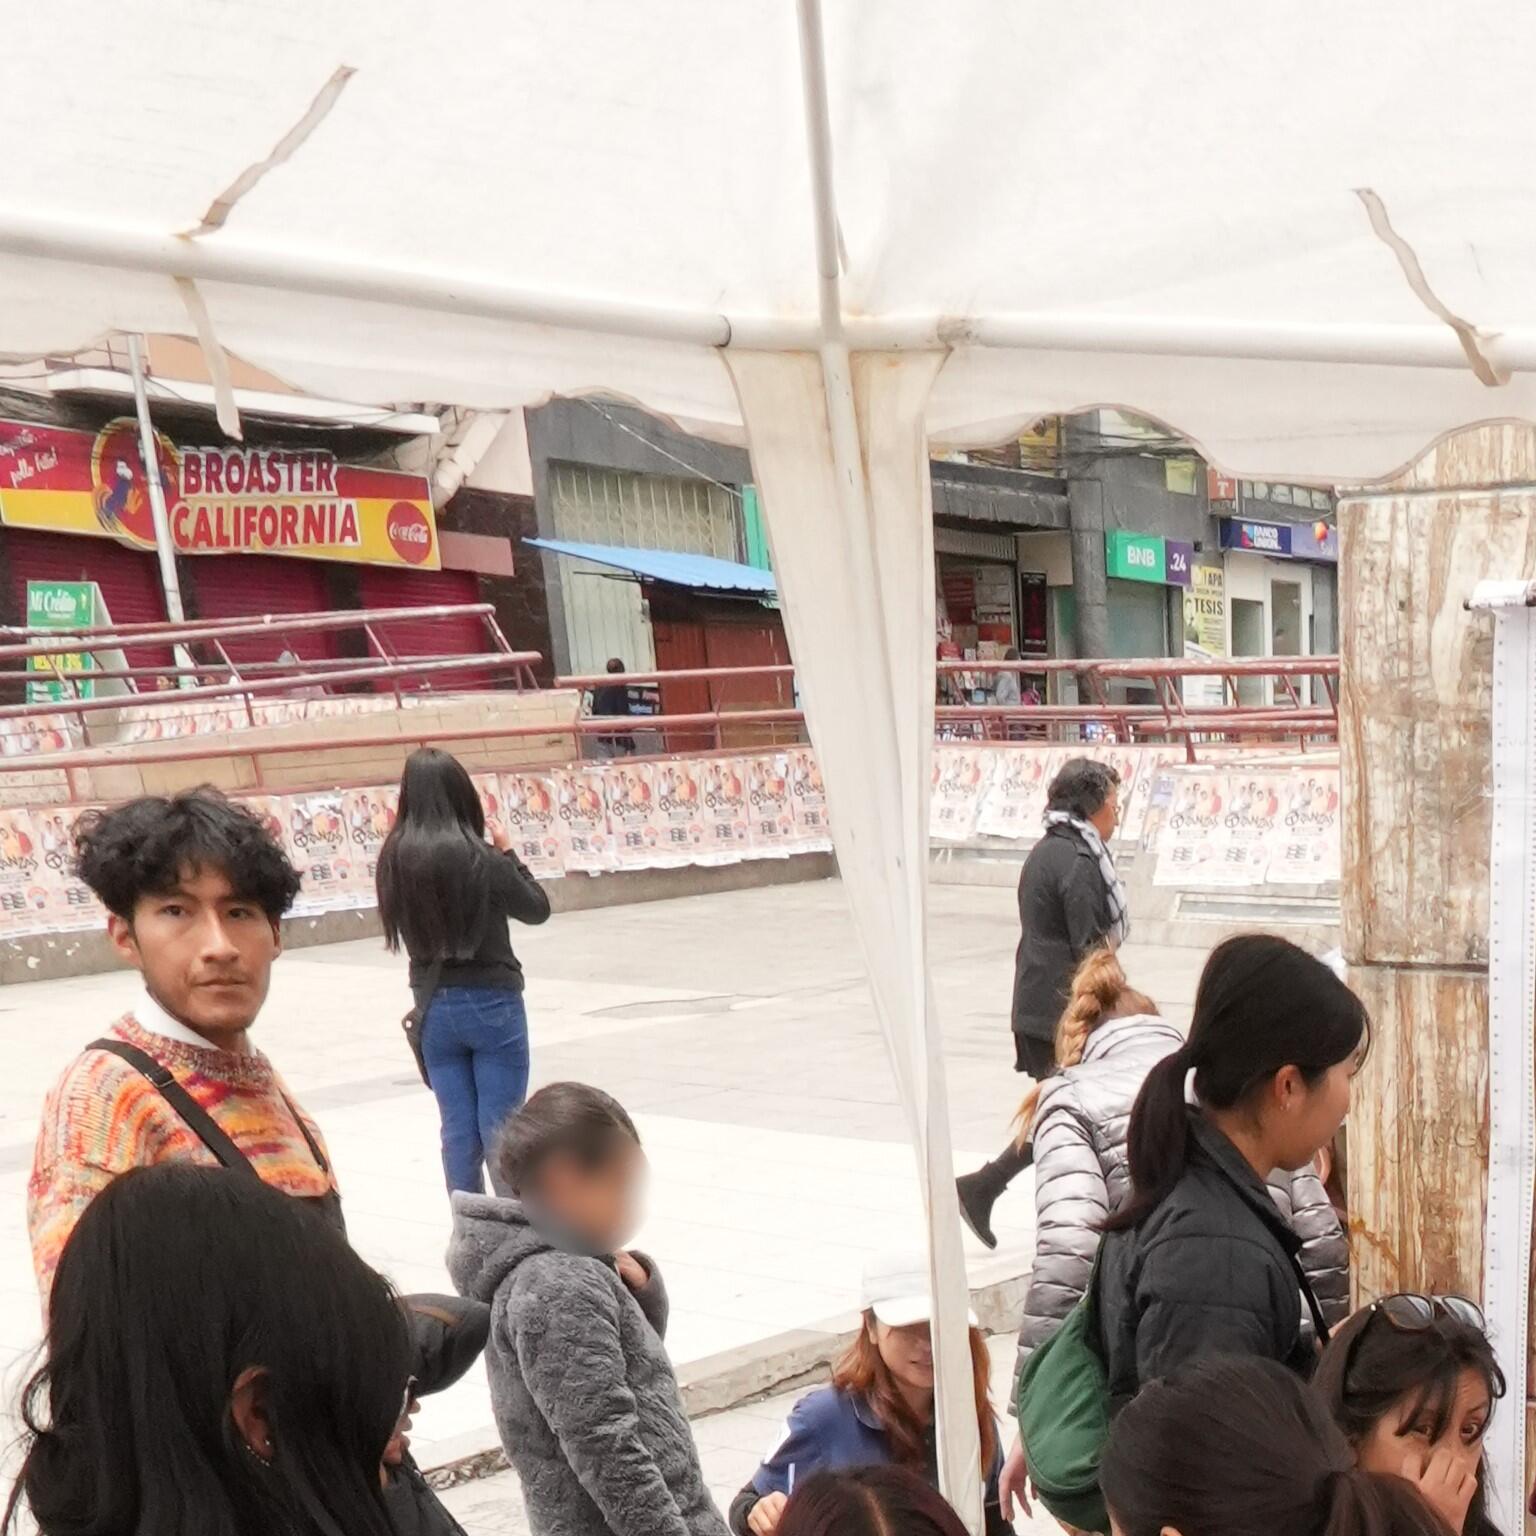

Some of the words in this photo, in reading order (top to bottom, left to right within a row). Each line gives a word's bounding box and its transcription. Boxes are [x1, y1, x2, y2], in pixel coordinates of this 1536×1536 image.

[183, 451, 335, 495] BROASTER
[173, 504, 358, 549] CALIFORNIA
[1127, 545, 1156, 568] BNB
[1194, 597, 1224, 616] TESIS
